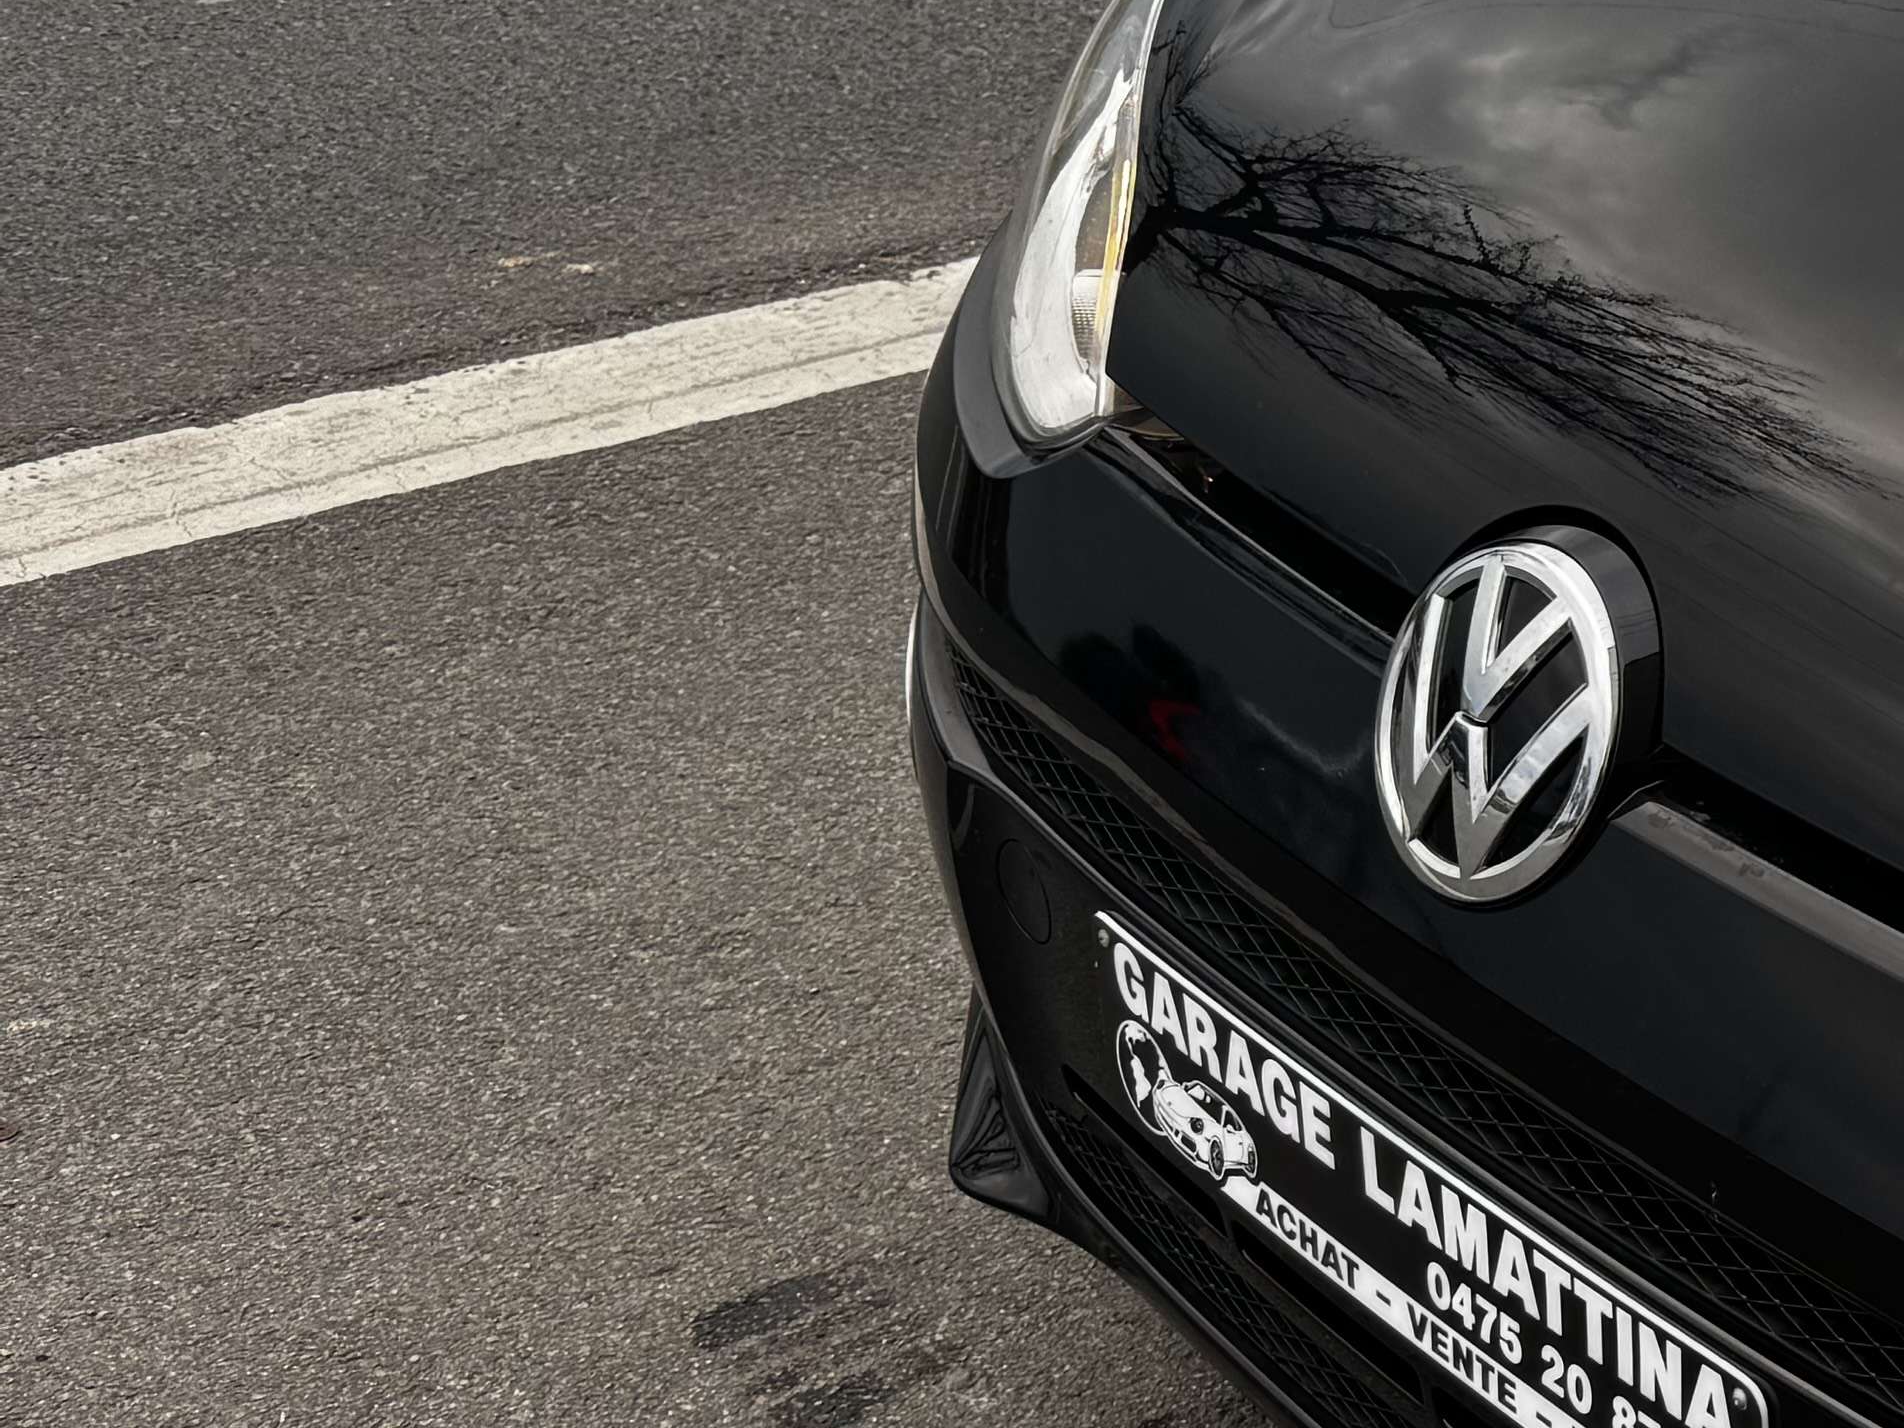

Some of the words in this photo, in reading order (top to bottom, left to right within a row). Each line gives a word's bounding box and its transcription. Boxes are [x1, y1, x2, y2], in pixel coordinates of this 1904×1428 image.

[1113, 942, 1336, 1170] GARAGE
[1255, 1188, 1360, 1290] ACHAT
[1407, 1302, 1517, 1414] VENTE
[1426, 1261, 1523, 1365] 0475
[1540, 1344, 1593, 1415] 20
